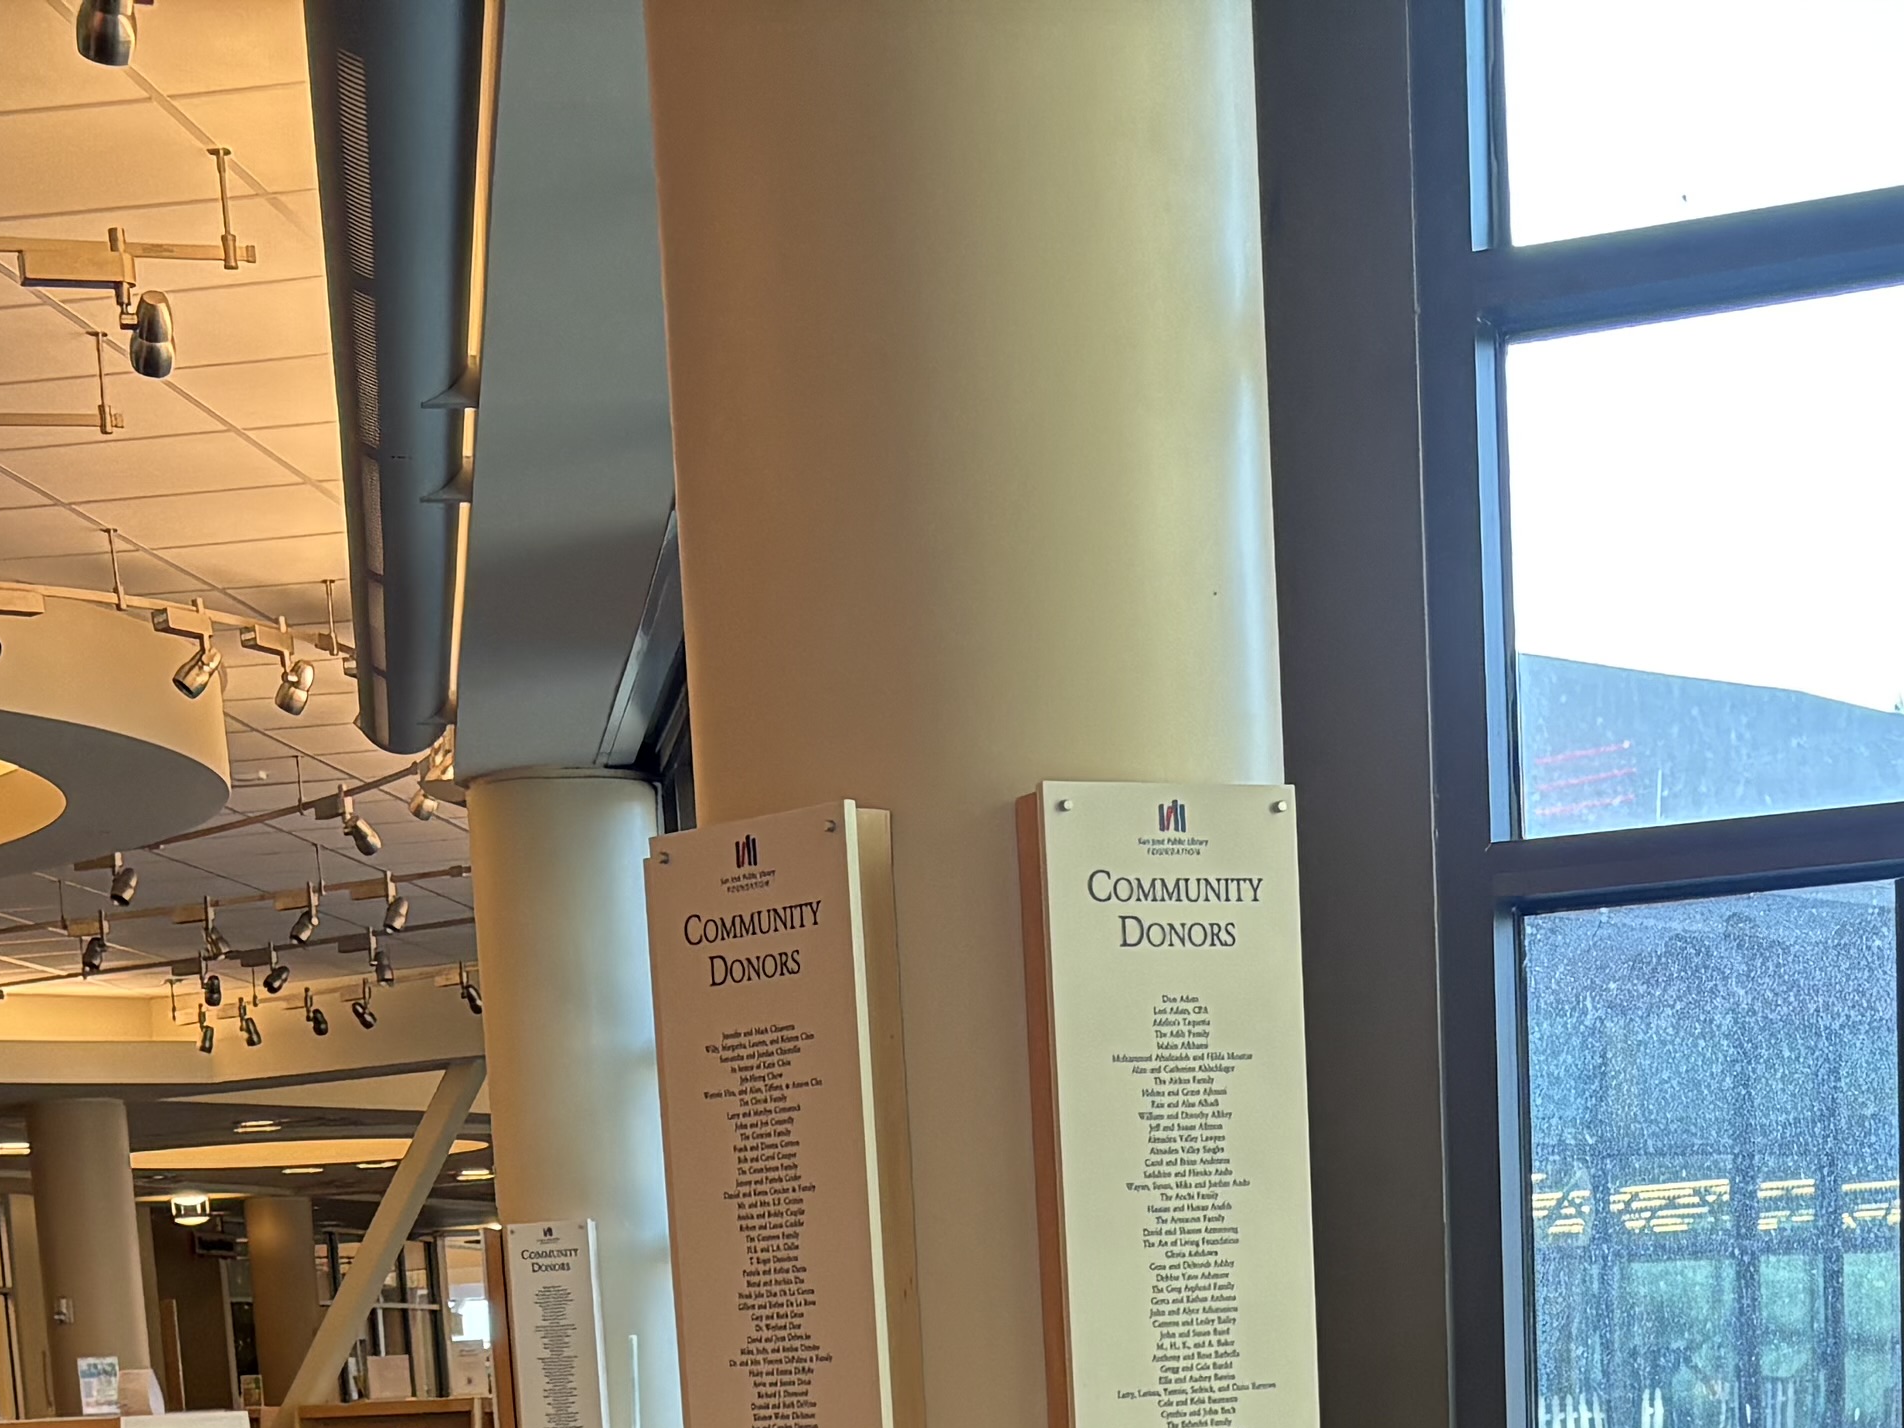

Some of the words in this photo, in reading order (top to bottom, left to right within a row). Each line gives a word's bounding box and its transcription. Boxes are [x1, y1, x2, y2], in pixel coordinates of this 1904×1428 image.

[1087, 870, 1263, 902] COMMUNITY
[684, 900, 821, 946] COMMUNITY
[1117, 915, 1236, 948] DONORS
[709, 950, 801, 987] DONORS
